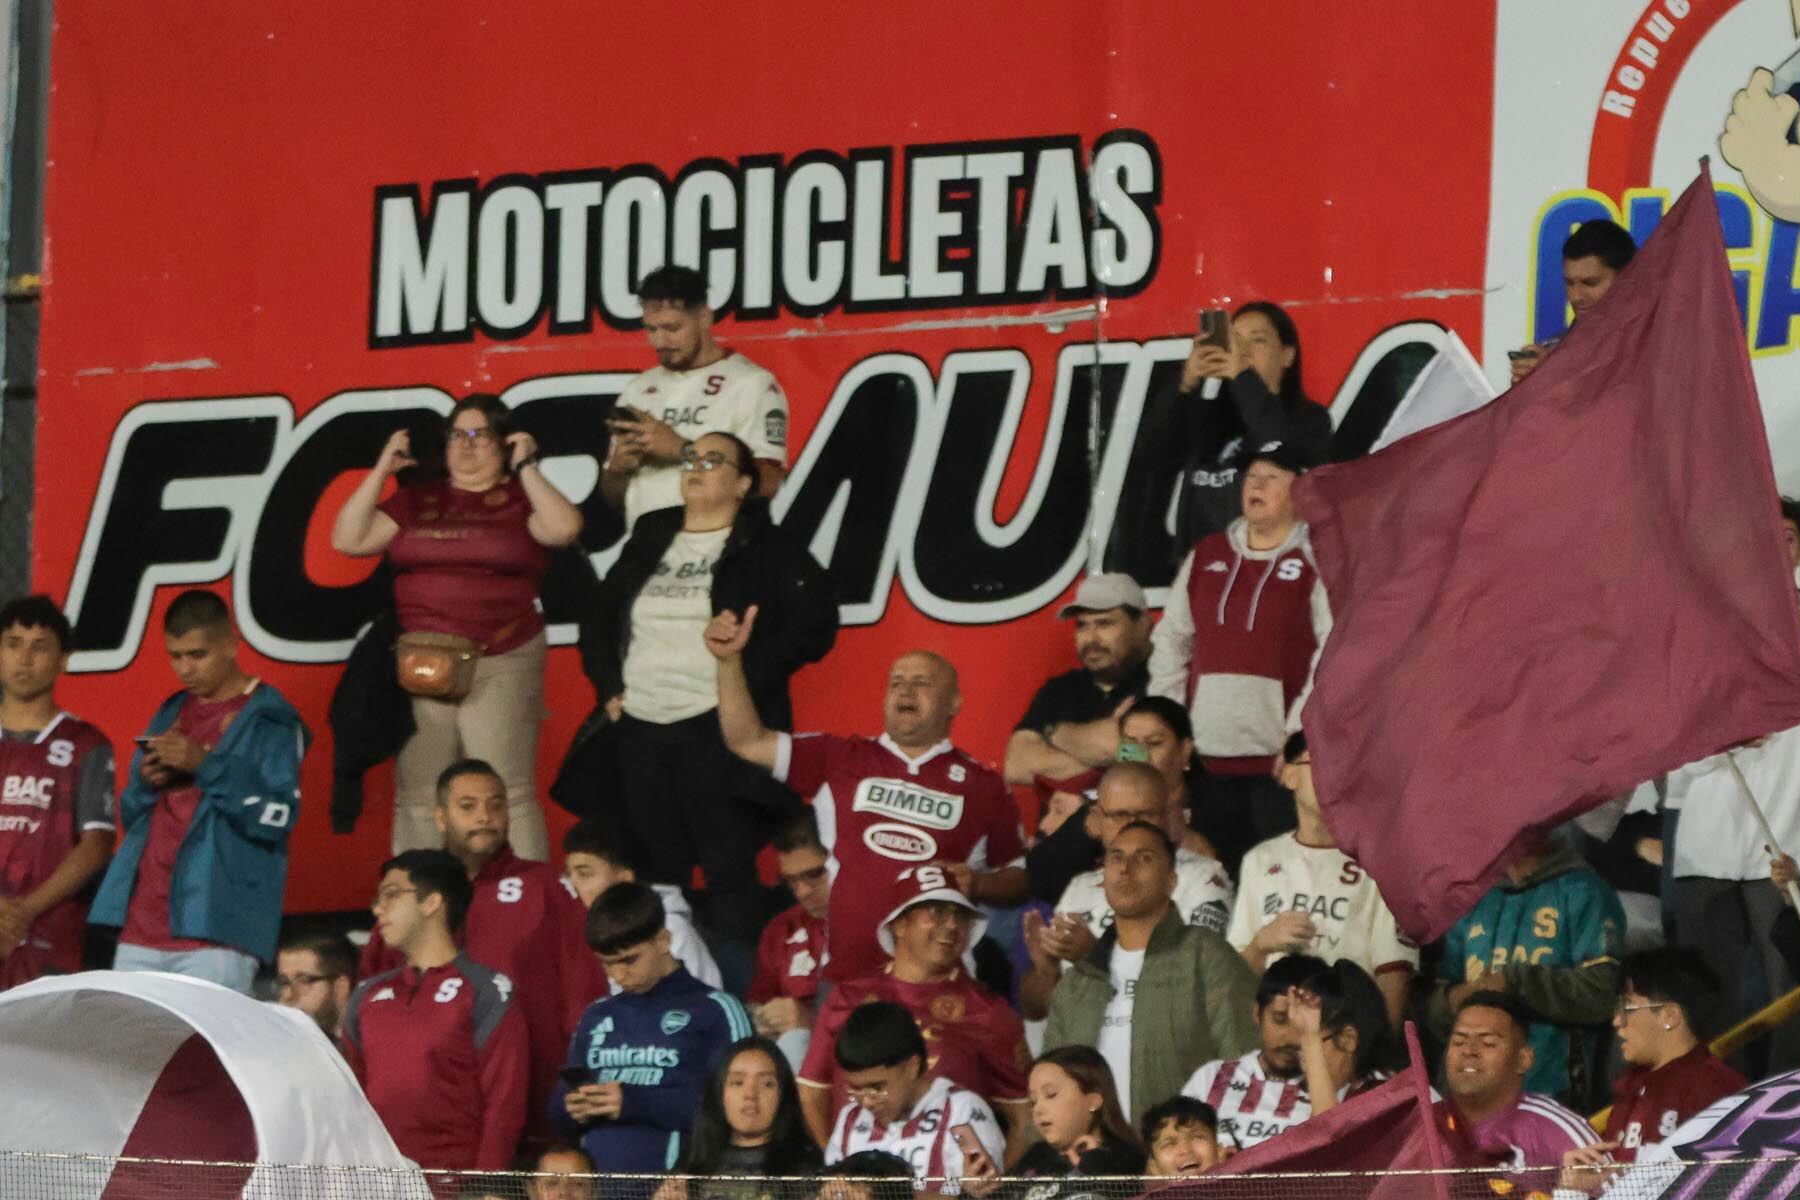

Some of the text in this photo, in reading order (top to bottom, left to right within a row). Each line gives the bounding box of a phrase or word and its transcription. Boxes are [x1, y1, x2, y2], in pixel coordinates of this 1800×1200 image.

[370, 130, 1160, 346] MOTOCICLETAS
[46, 739, 75, 767] S
[2, 776, 55, 801] BAC
[866, 784, 956, 822] BIMBO
[497, 877, 522, 902] S
[1291, 894, 1349, 922] BAC
[1533, 906, 1561, 939] S
[433, 978, 463, 1004] S
[586, 1043, 680, 1070] Emirates
[1246, 1119, 1288, 1138] BA
